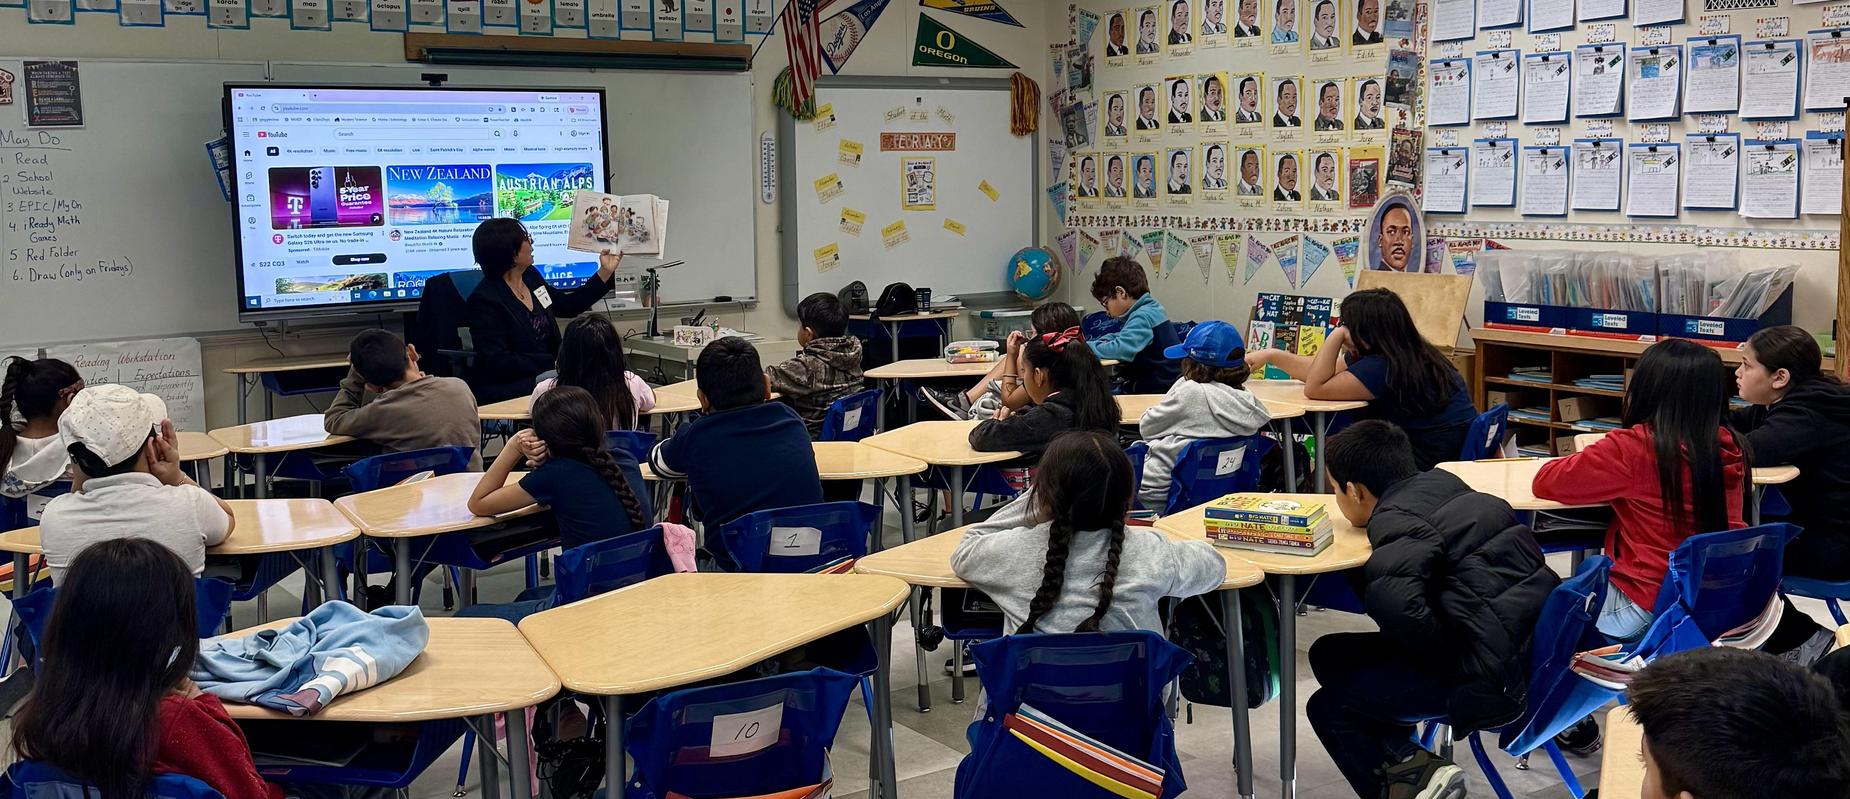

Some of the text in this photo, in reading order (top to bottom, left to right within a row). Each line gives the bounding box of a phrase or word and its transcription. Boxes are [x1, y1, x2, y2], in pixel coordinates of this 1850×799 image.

[376, 2, 401, 10] octopus
[963, 5, 997, 14] BRUINS
[859, 10, 871, 20] Los
[827, 24, 848, 56] Dodgers
[919, 45, 968, 65] OREGON
[1356, 49, 1375, 59] Edith
[0, 130, 61, 147] May Do
[893, 134, 944, 149] FEBRUARY
[15, 152, 49, 166] Read
[18, 171, 54, 183] School
[388, 166, 490, 181] NEW ZEALAND
[340, 186, 370, 194] 5-Year
[500, 177, 593, 190] AUSTRIAN ALPS
[13, 186, 54, 196] Website
[340, 192, 372, 202] Price
[7, 202, 14, 213] 3
[1314, 204, 1334, 213] Nathan
[9, 222, 16, 232] 4
[57, 216, 81, 226] Math
[29, 232, 58, 244] Games
[10, 245, 78, 262] 5 Red Folder
[29, 268, 57, 282] Draw
[85, 267, 97, 276] on
[1269, 294, 1280, 302] CAT
[1518, 308, 1538, 316] Leveled
[1260, 331, 1270, 348] B
[74, 349, 176, 372] Reading Workstation
[134, 368, 192, 383] Expectations
[1566, 404, 1572, 415] 7
[1221, 456, 1236, 470] 24
[784, 533, 800, 548] 1
[1243, 536, 1264, 544] NATE
[734, 722, 760, 740] 10
